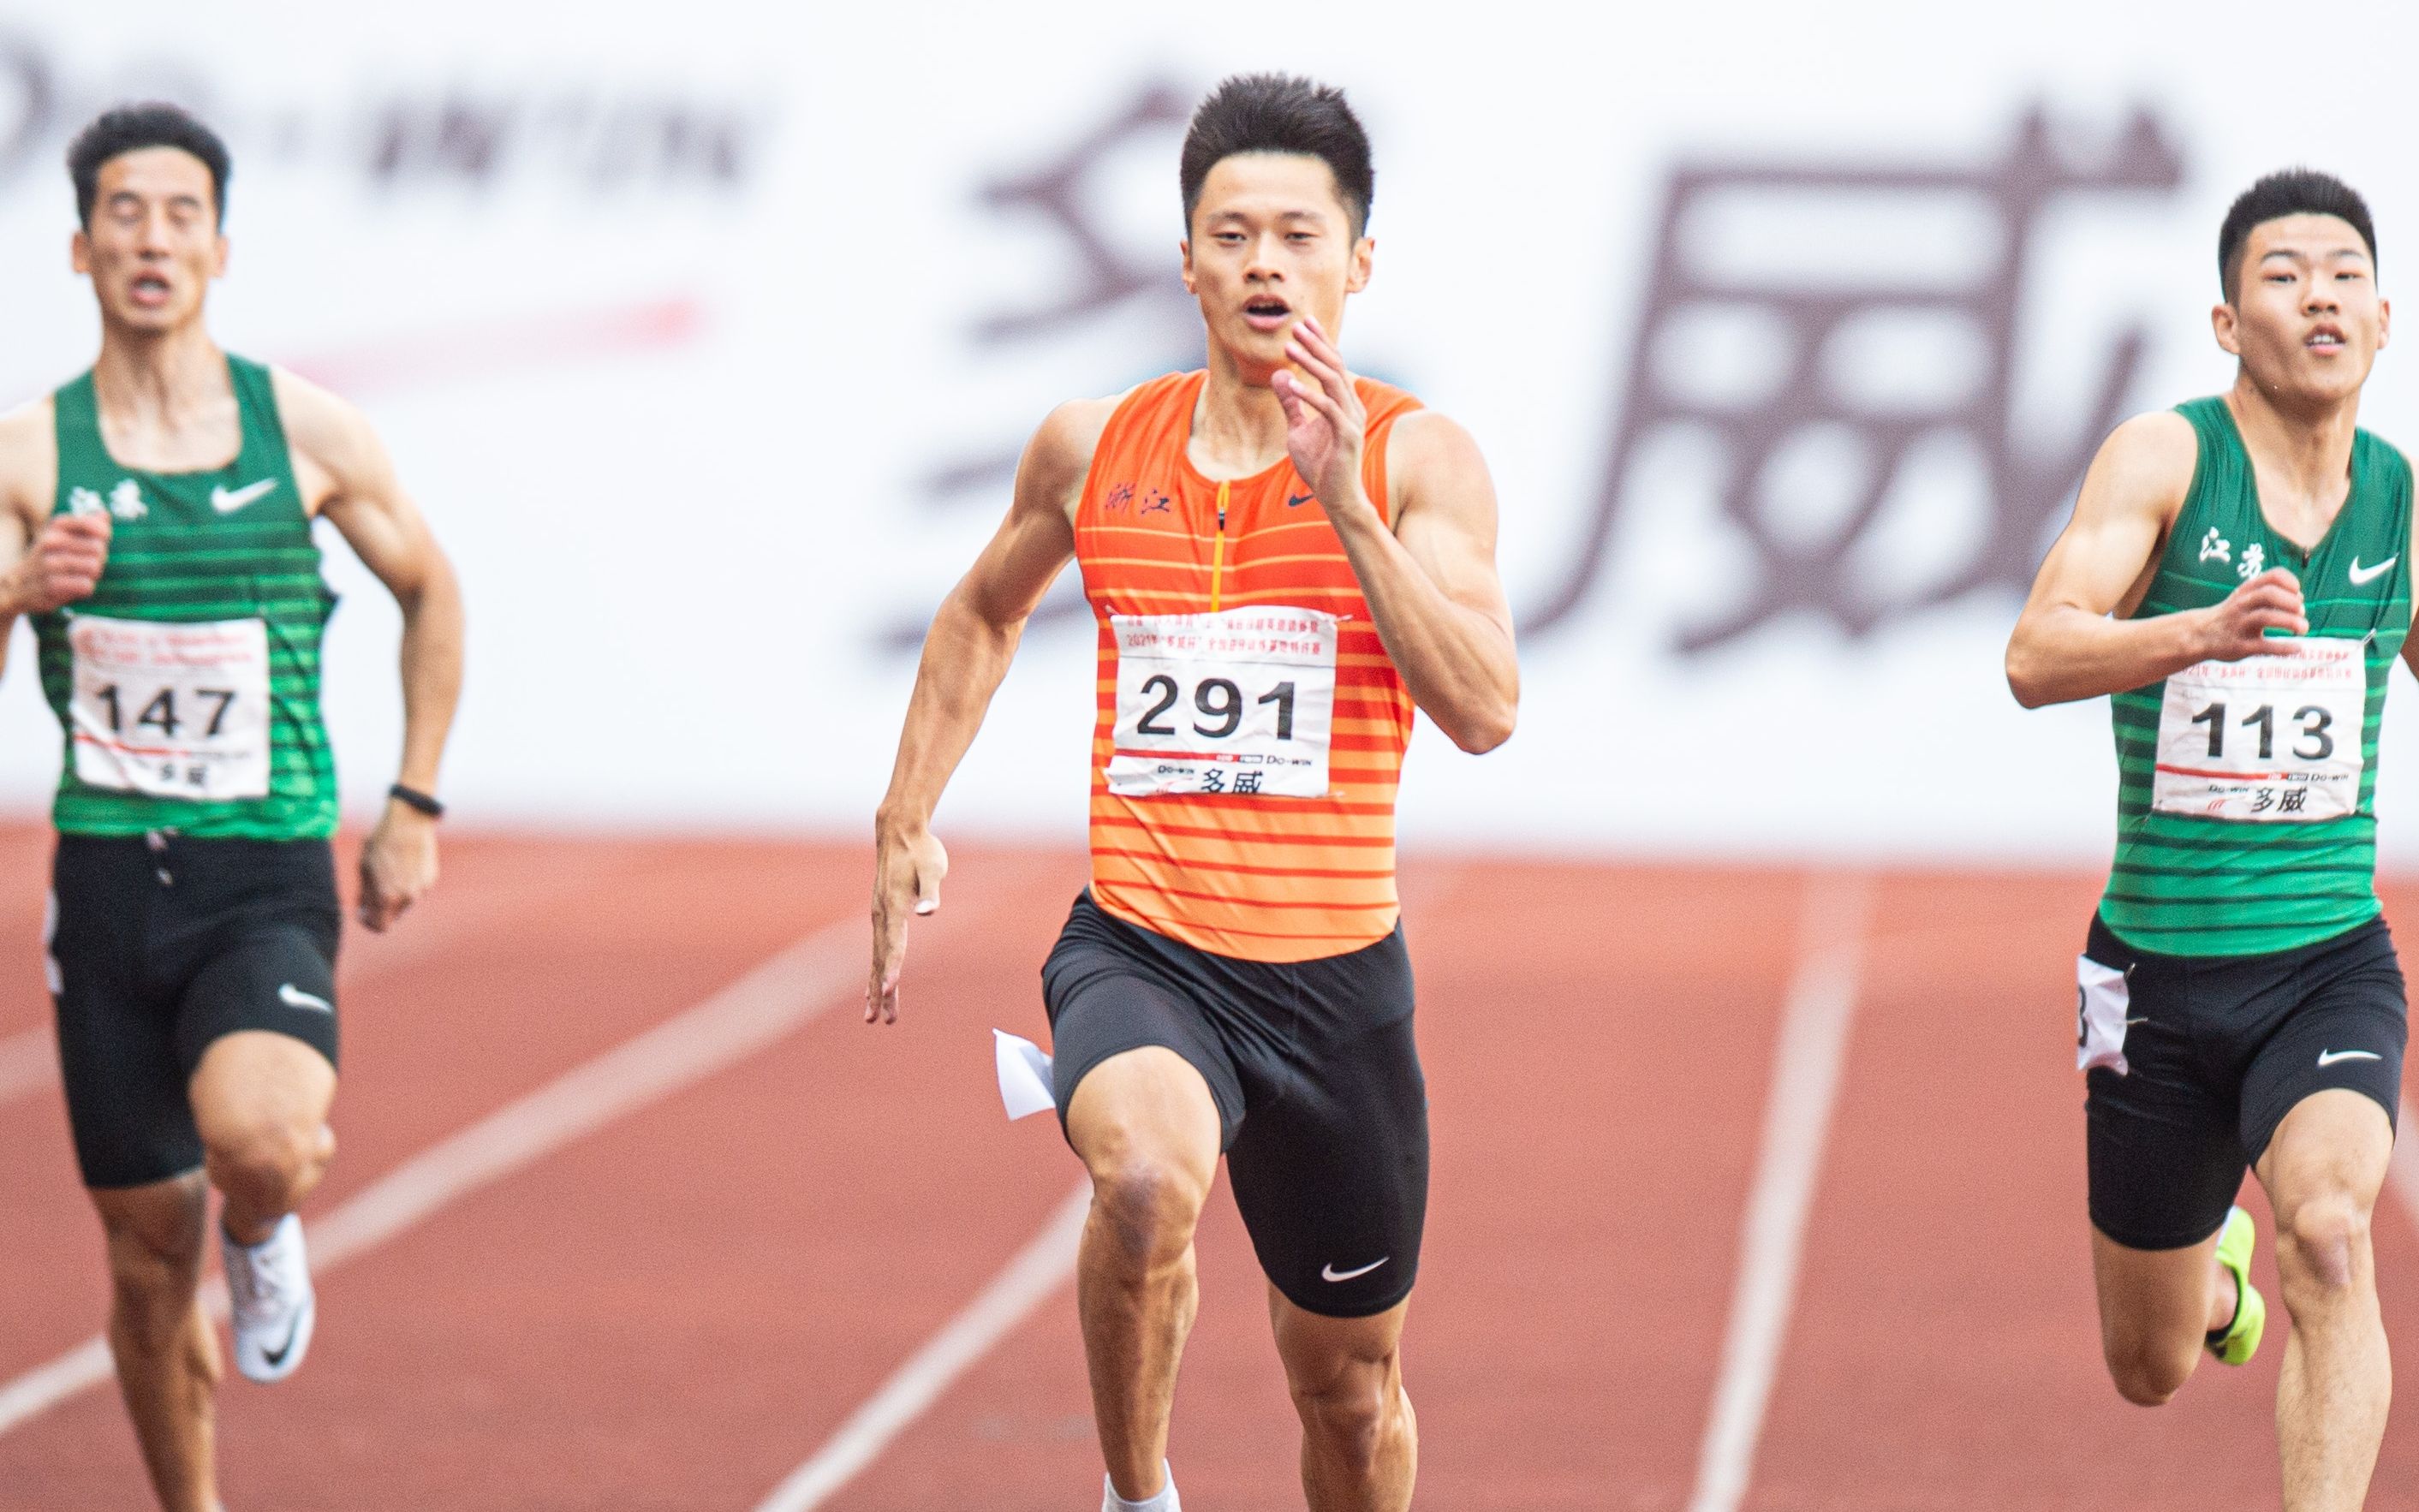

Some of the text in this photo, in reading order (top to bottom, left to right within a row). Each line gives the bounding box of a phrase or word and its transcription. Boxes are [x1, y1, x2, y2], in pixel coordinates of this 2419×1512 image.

[96, 682, 236, 737] 147
[1137, 674, 1296, 741] 291
[2191, 702, 2334, 760] 113
[1201, 768, 1264, 793] 多威
[2250, 785, 2308, 813] 多威
